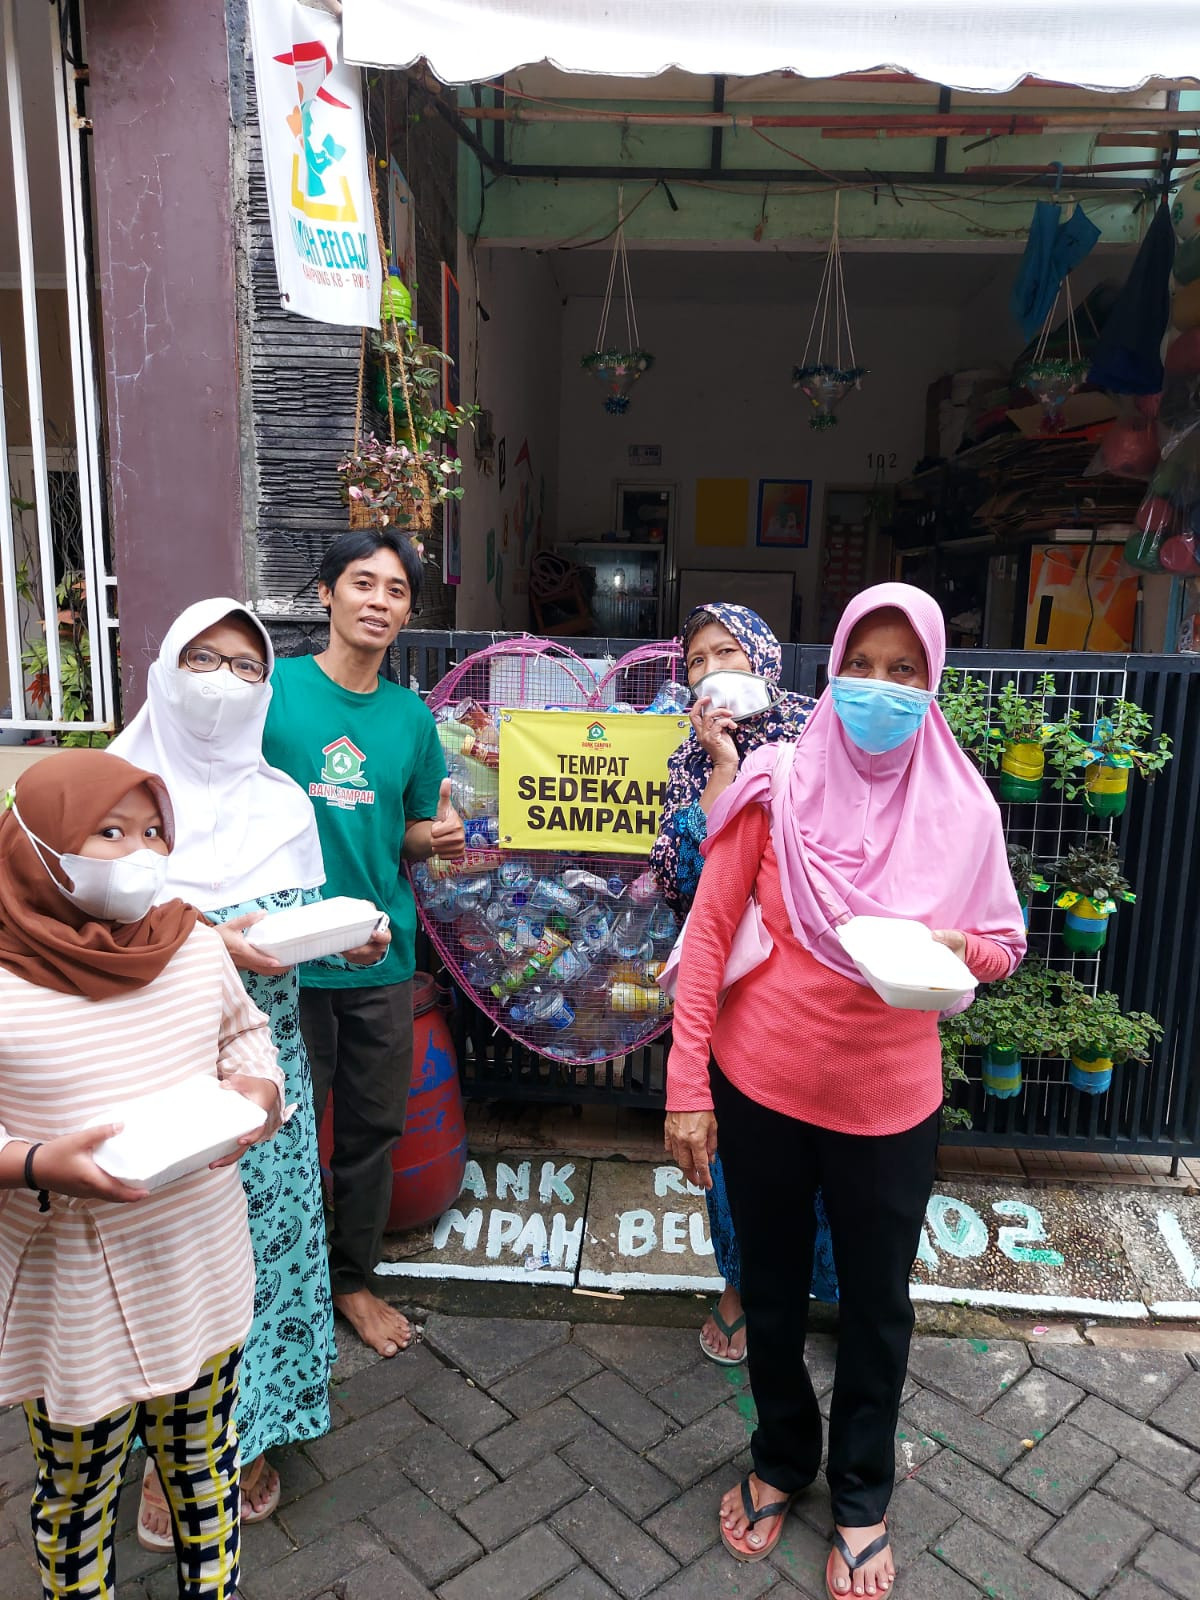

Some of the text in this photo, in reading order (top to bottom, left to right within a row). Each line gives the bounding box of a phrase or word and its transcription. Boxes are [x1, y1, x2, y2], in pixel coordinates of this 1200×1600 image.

[867, 452, 897, 469] 102
[558, 754, 629, 777] TEMPAT
[309, 783, 374, 803] BANK SAMPAH
[518, 775, 666, 806] SEDEKAH
[527, 805, 656, 834] SAMPAH
